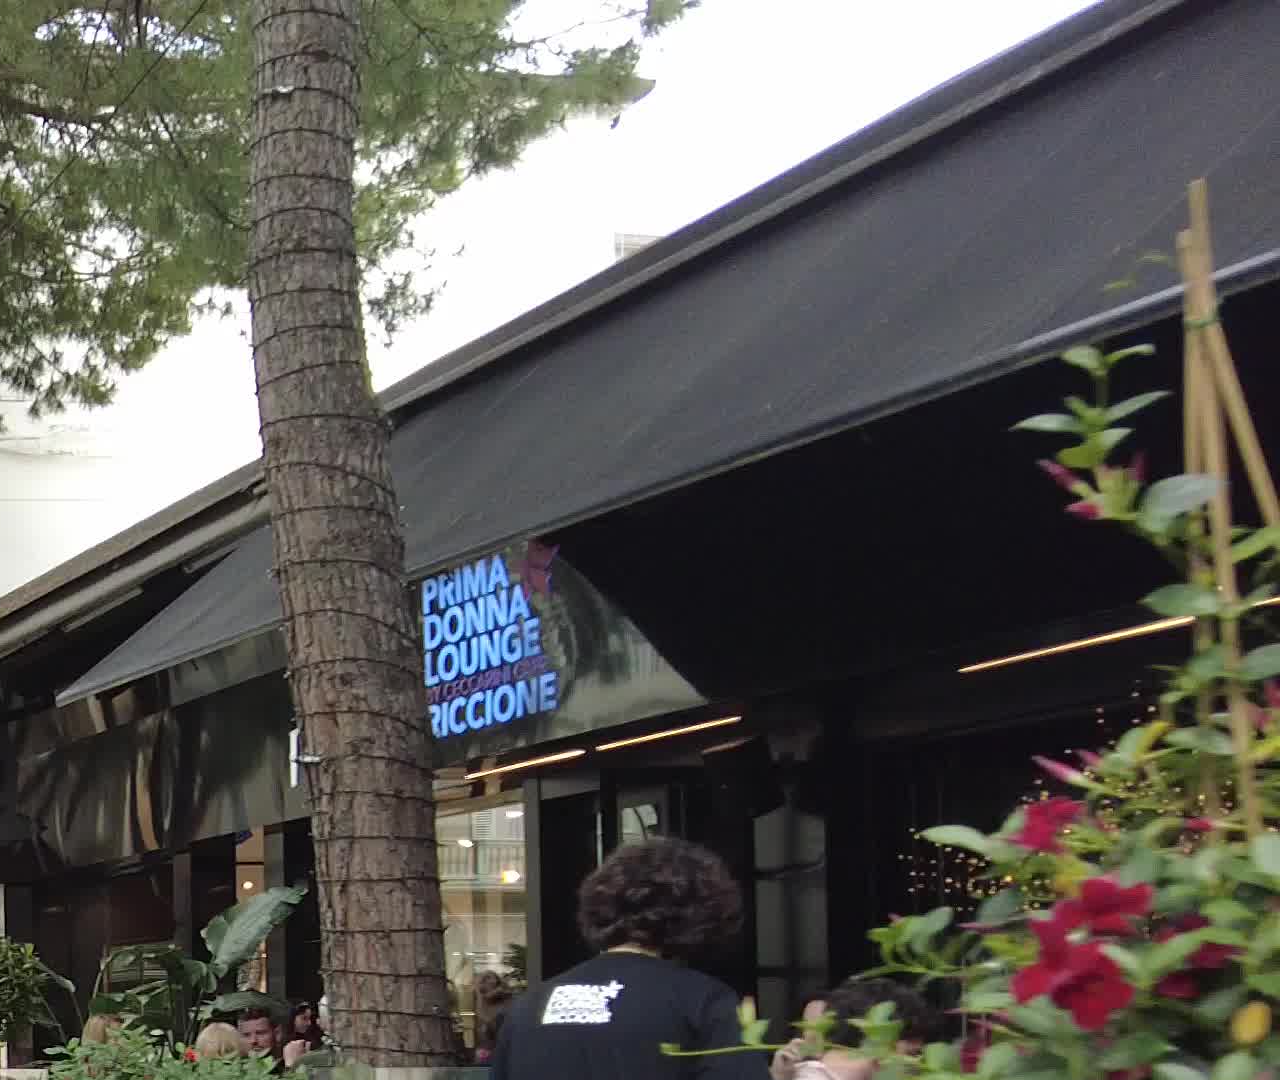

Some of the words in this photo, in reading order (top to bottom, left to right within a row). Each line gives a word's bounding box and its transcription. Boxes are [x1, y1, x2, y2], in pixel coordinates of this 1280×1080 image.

[422, 553, 510, 615] PRIMA
[423, 584, 531, 651] DONNA
[424, 617, 541, 687] LOUNGE
[427, 671, 558, 739] RICCIONE
